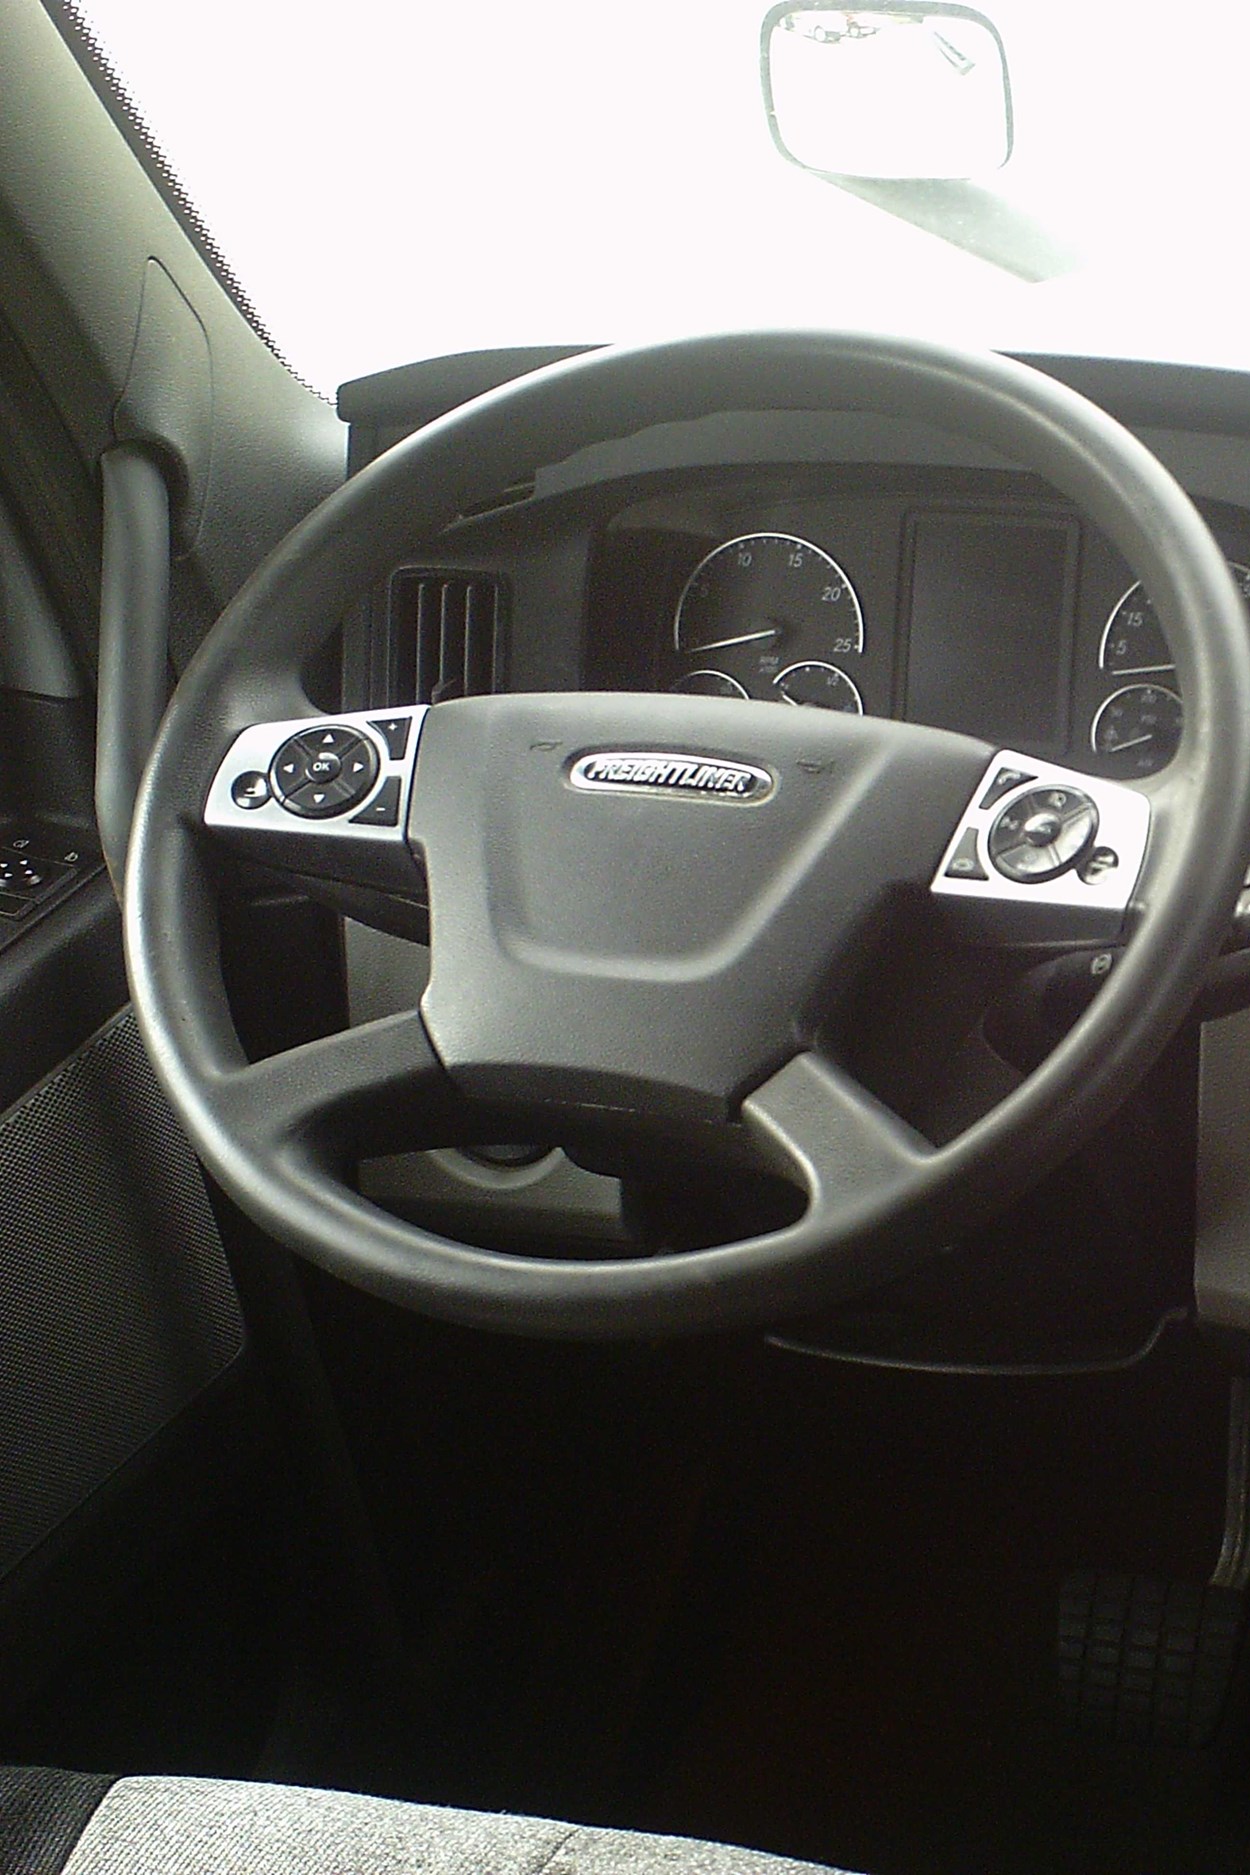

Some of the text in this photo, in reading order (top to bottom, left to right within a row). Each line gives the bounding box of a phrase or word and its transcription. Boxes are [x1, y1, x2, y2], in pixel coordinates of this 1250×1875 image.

[737, 553, 752, 567] 10
[788, 554, 803, 567] 15
[821, 587, 841, 602] 20
[1126, 612, 1143, 627] 15
[833, 638, 852, 652] 25
[1116, 640, 1127, 655] 5
[313, 761, 330, 771] OK
[587, 758, 753, 792] FREIGHTLINER
